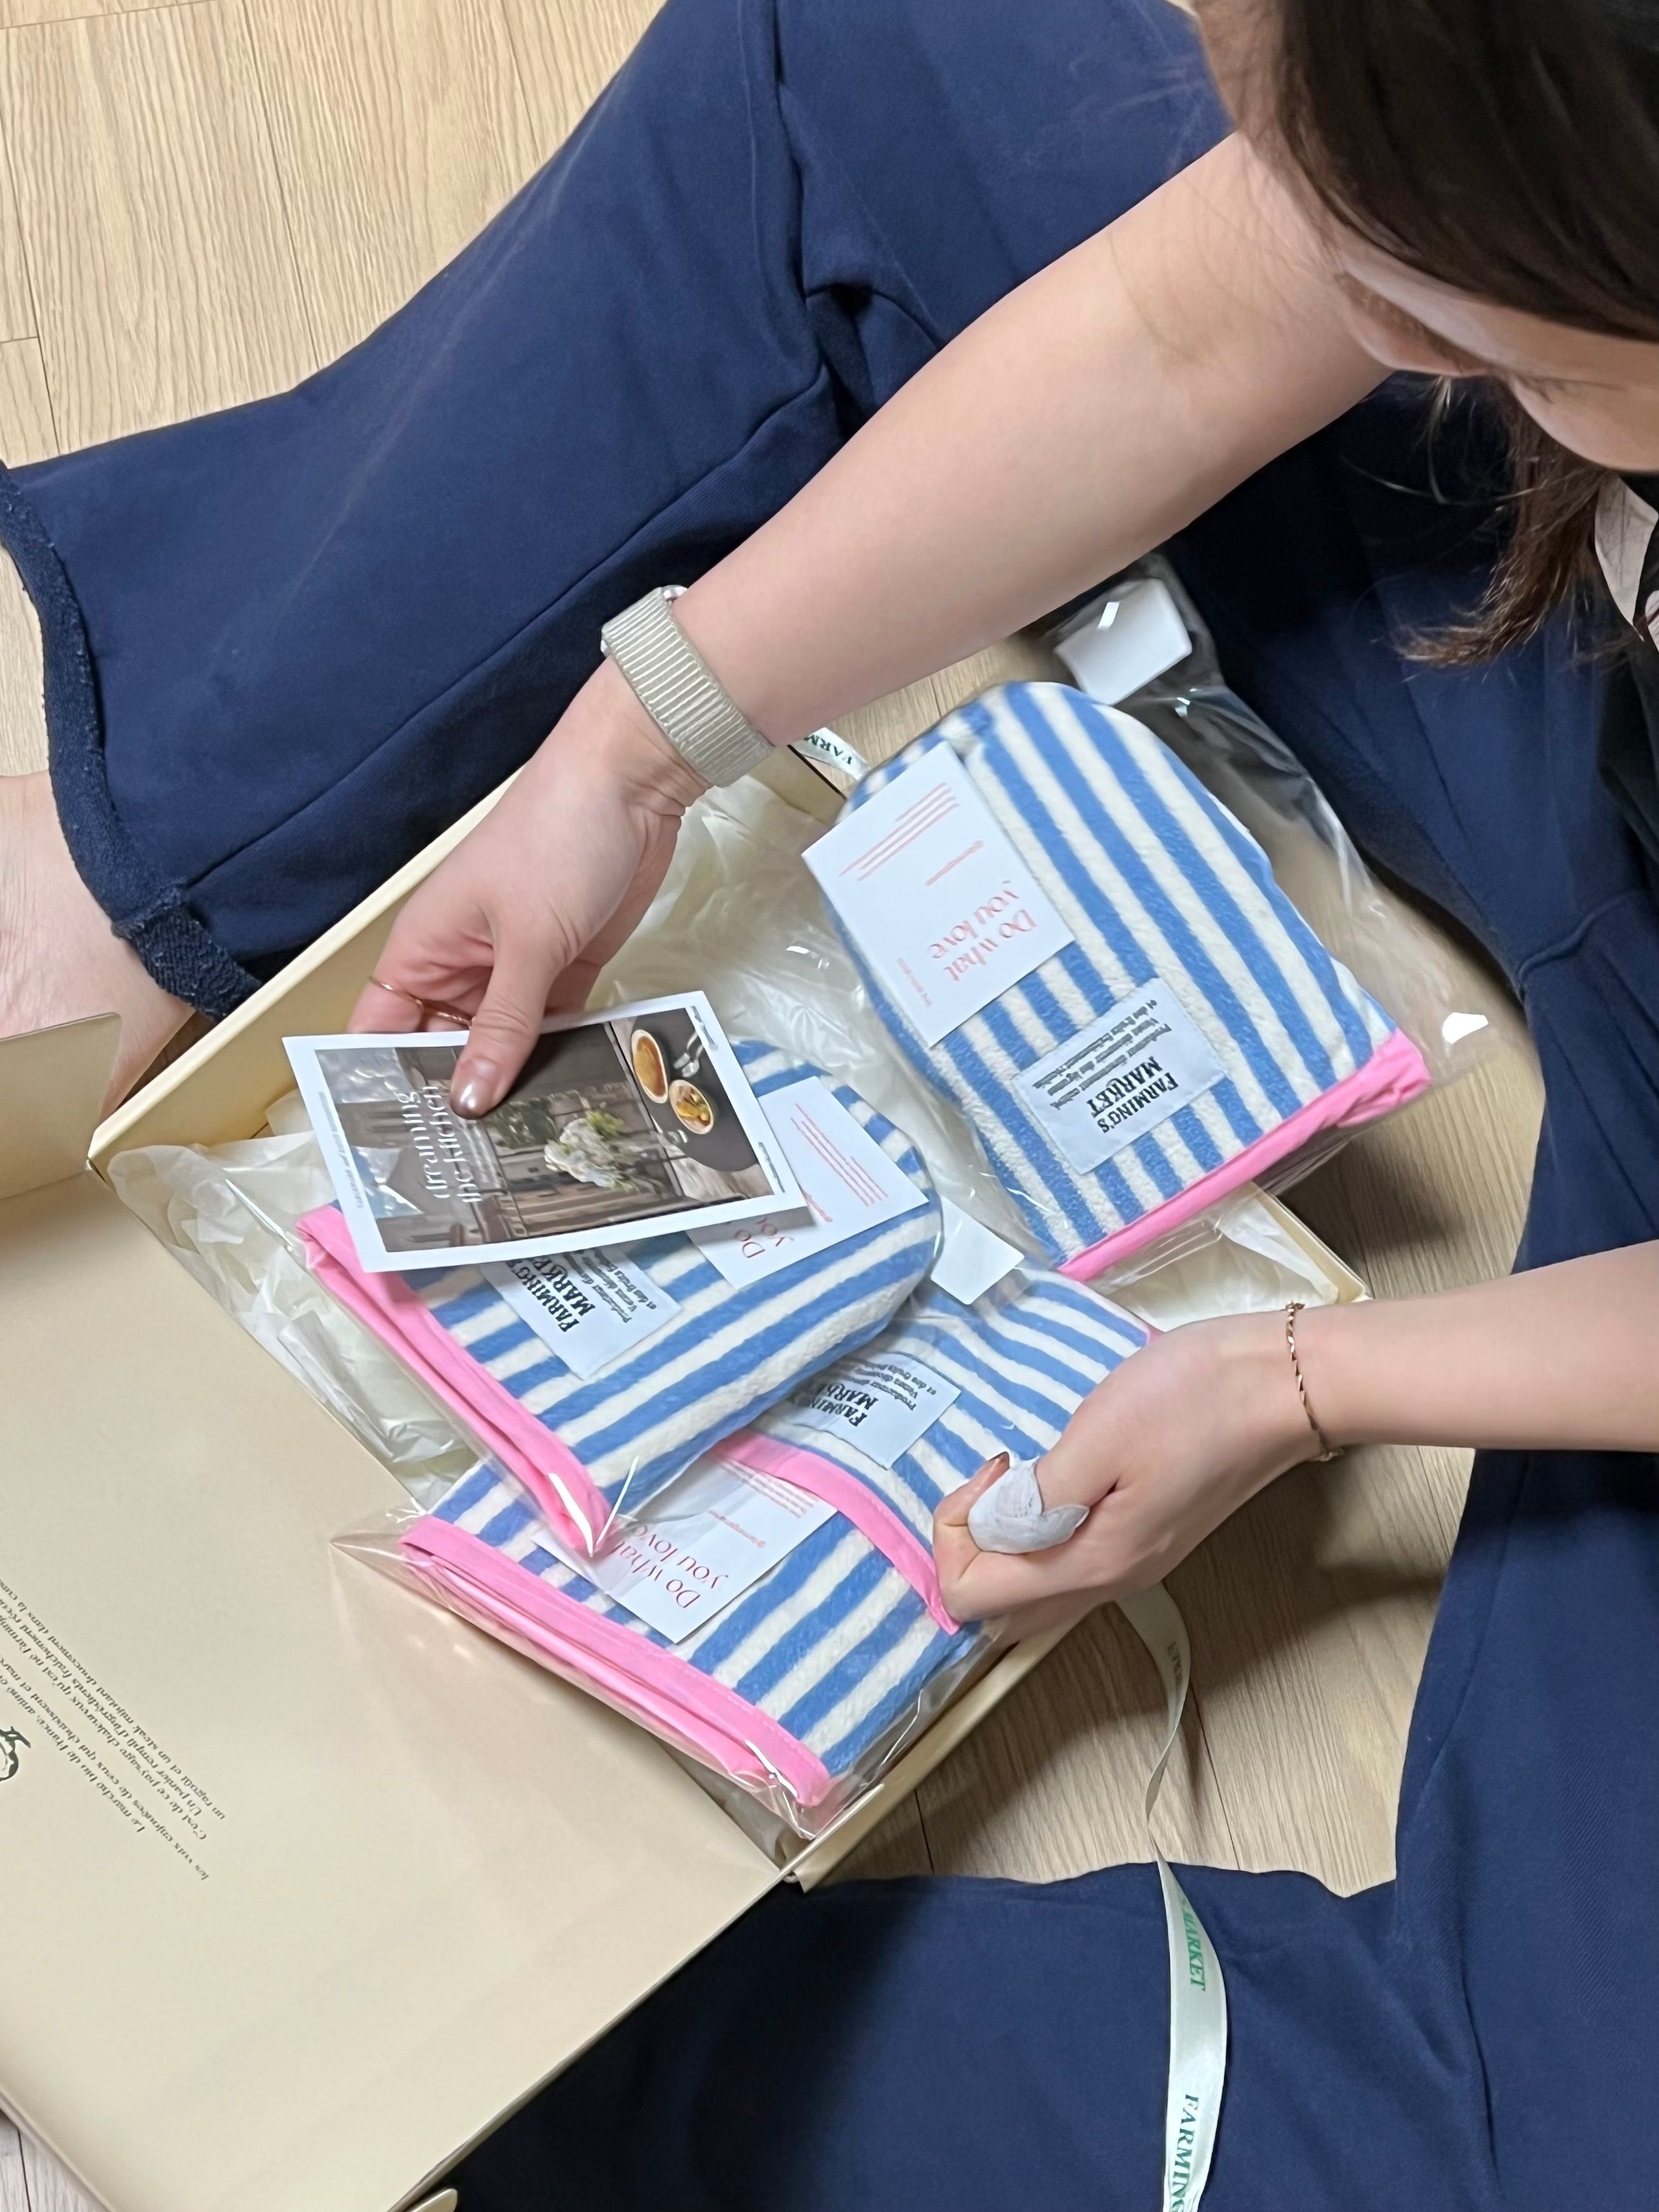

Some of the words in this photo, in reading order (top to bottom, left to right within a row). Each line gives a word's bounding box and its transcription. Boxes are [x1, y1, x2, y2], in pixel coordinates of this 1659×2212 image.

[996, 907, 1037, 938] Do
[927, 920, 979, 959] love
[1086, 1056, 1163, 1118] MARKET
[732, 1228, 766, 1259] Do
[677, 1556, 728, 1590] you
[666, 1578, 702, 1609] Do
